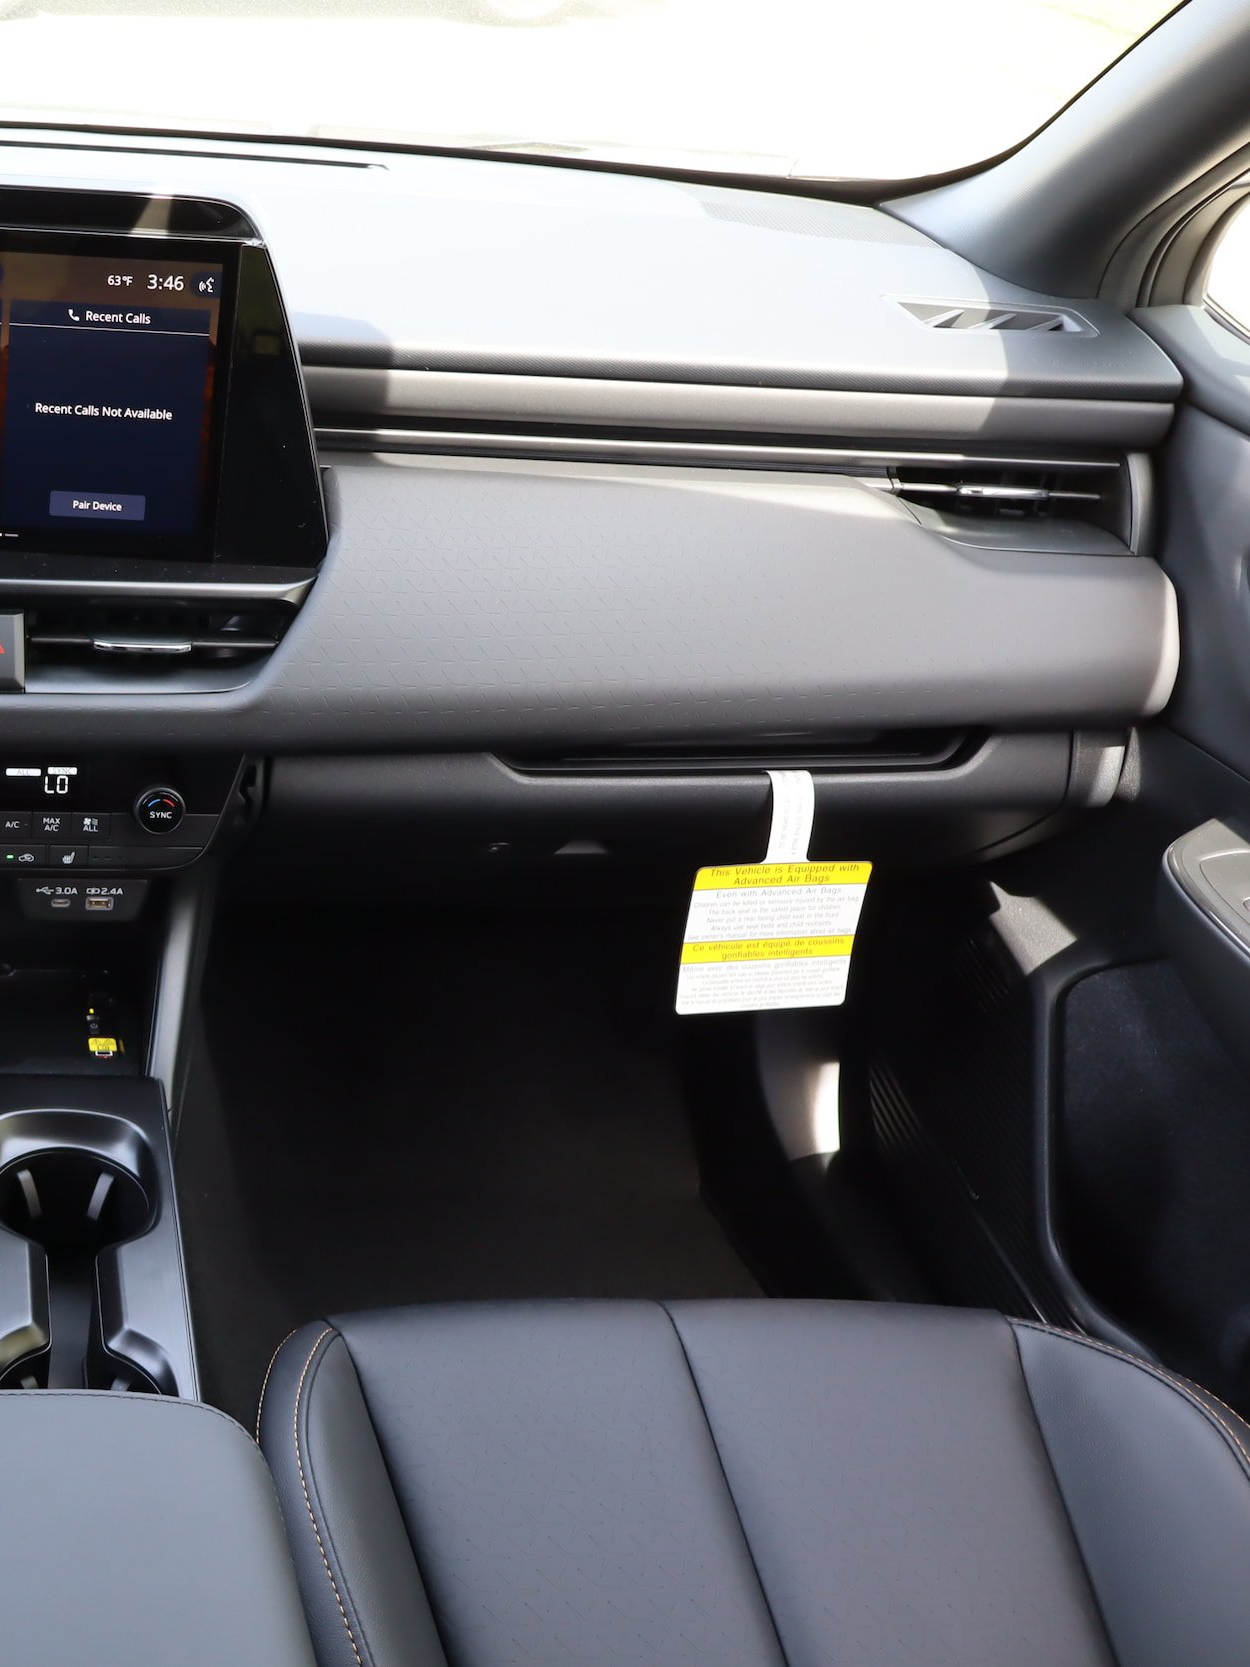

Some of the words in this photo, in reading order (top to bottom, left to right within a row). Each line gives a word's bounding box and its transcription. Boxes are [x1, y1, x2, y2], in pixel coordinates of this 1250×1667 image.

[107, 275, 134, 287] 63°F
[146, 274, 184, 291] 3:46
[85, 310, 124, 323] Recent
[125, 313, 151, 325] Calls
[35, 402, 72, 415] Recent
[74, 405, 100, 416] Calls
[102, 406, 122, 417] Not
[124, 408, 173, 421] Available
[72, 500, 91, 510] Pair
[92, 501, 122, 512] Device
[52, 767, 73, 775] SYNC
[45, 775, 69, 794] LO
[149, 811, 172, 819] SYNC
[44, 824, 60, 832] A/C
[711, 868, 730, 876] This
[735, 867, 770, 875] Vehicle
[787, 864, 835, 874] Equipped
[733, 876, 782, 885] Advanced
[804, 874, 830, 884] Bags
[55, 887, 78, 895] 3.0A
[100, 887, 123, 895] 2.4A
[760, 888, 803, 896] Advanced
[820, 886, 842, 895] Bags
[708, 942, 742, 950] véhicule
[763, 939, 791, 949] équipé
[808, 938, 845, 946] coussins
[721, 950, 765, 960] gonflables
[768, 948, 813, 957] intelligents
